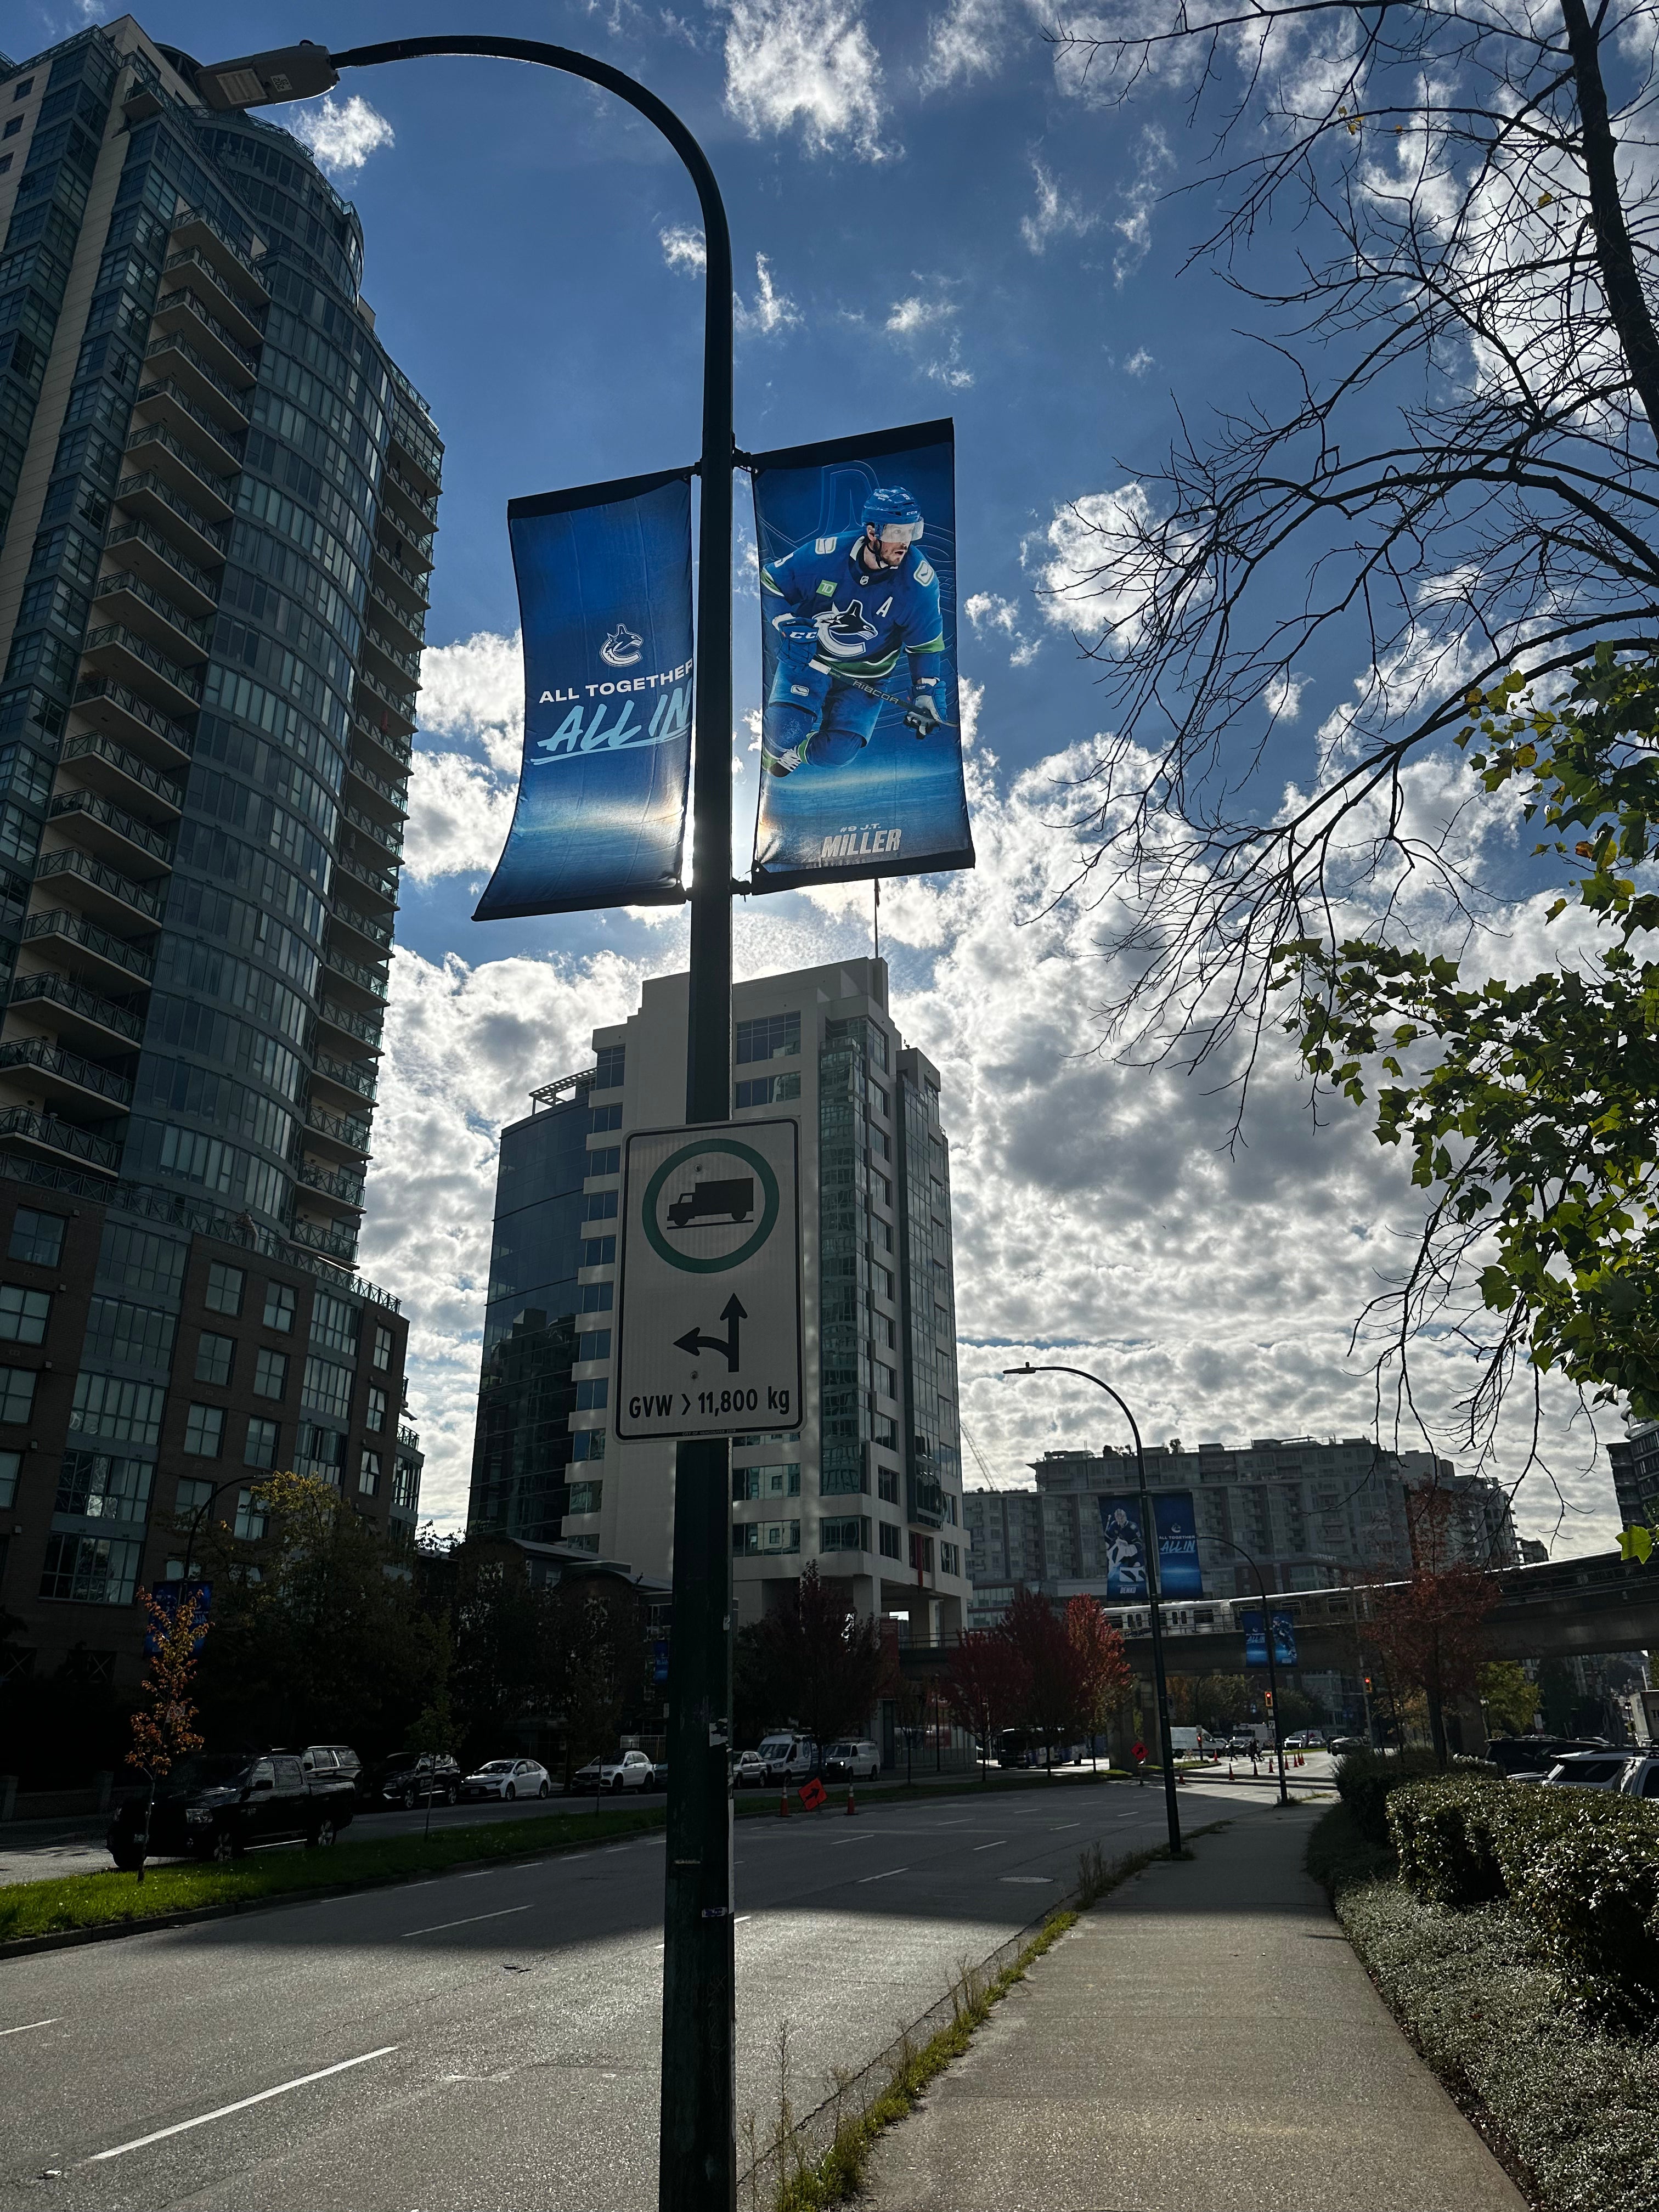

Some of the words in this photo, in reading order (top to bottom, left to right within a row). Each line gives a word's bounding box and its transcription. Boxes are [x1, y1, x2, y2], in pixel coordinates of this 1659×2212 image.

[822, 583, 834, 594] TD
[876, 596, 893, 618] A
[539, 687, 580, 703] ALL
[585, 658, 693, 697] TOGETHER
[852, 681, 900, 704] RIBCOR
[537, 699, 642, 752] ALL
[648, 678, 693, 741] IN
[821, 828, 902, 858] MILLER
[629, 1394, 673, 1419] GVW
[681, 1393, 691, 1415] >
[698, 1389, 758, 1417] 11,800
[768, 1386, 789, 1415] kg
[1160, 1541, 1181, 1552] ALL
[1183, 1540, 1195, 1551] IN
